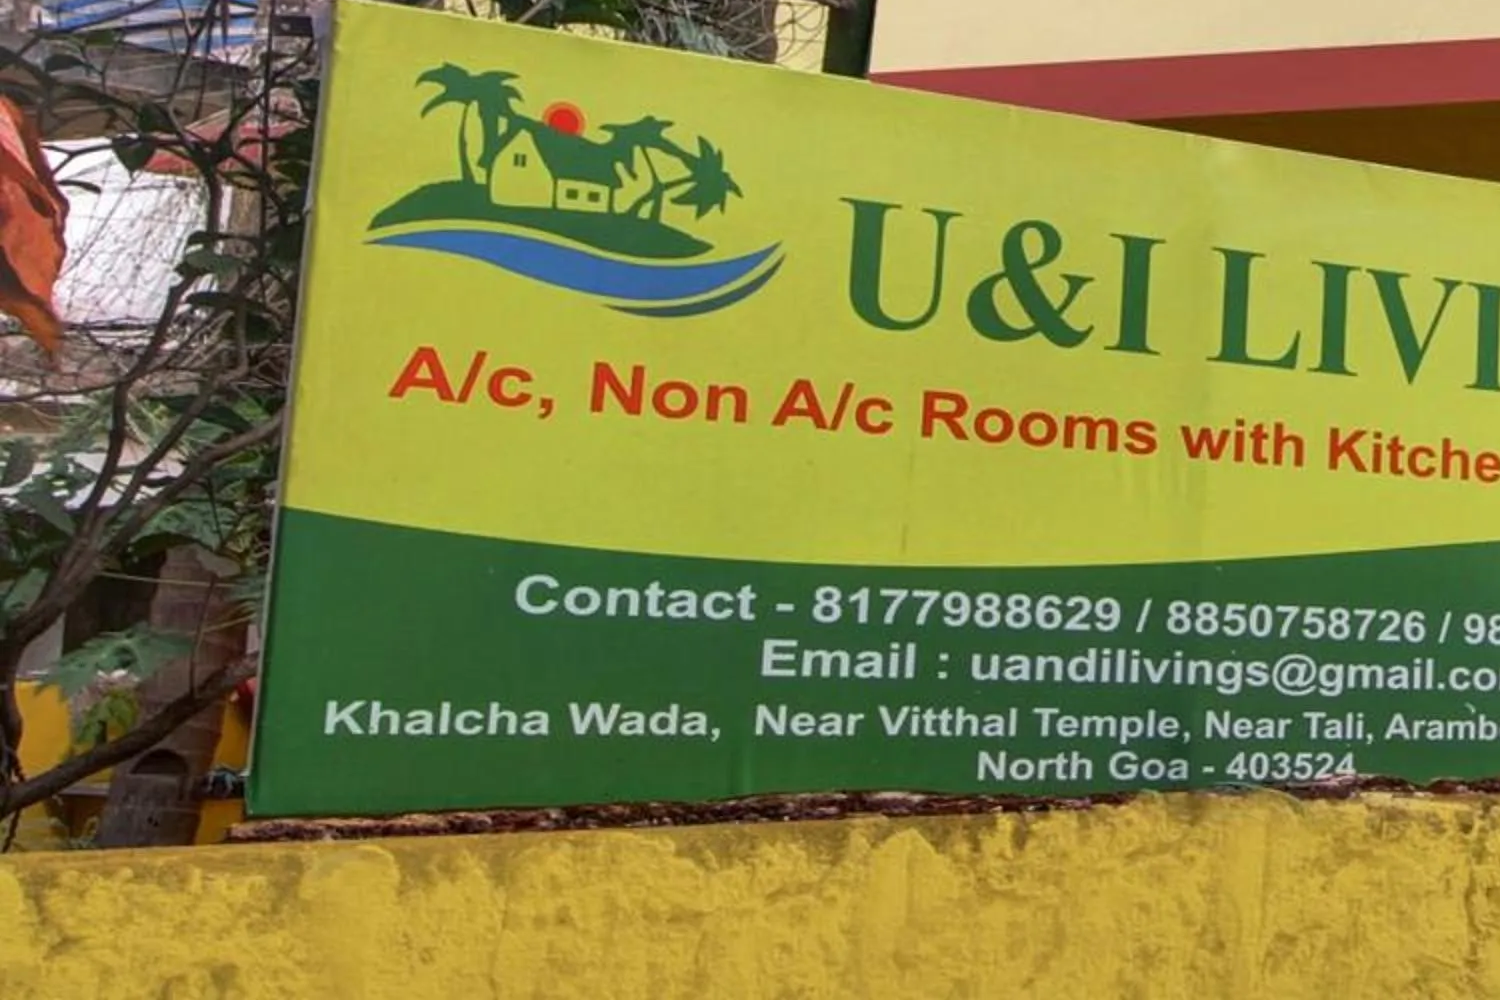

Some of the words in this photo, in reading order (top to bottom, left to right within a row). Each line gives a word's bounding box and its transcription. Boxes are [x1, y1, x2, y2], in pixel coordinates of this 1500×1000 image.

[389, 346, 556, 418] A/c,
[590, 362, 749, 423] Non
[773, 380, 891, 436] A/c
[922, 390, 1157, 455] Rooms
[1181, 418, 1305, 466] with
[515, 574, 757, 621] Contact
[775, 603, 795, 612] -
[812, 585, 1121, 632] 8177988629
[1135, 599, 1152, 633] /
[1166, 600, 1426, 643] 8850758726
[1438, 611, 1452, 644] /
[761, 639, 916, 679] Email
[938, 653, 949, 679] :
[324, 700, 549, 736] Khalcha
[569, 702, 721, 742] Wada,
[755, 704, 865, 736] Near
[879, 705, 1018, 737] Vitthal
[1033, 707, 1190, 745] Temple,
[1205, 710, 1293, 739] Near
[1303, 711, 1374, 745] Tali,
[977, 751, 1093, 781] North
[1109, 750, 1188, 781] Goa
[1225, 752, 1356, 780] 403524
